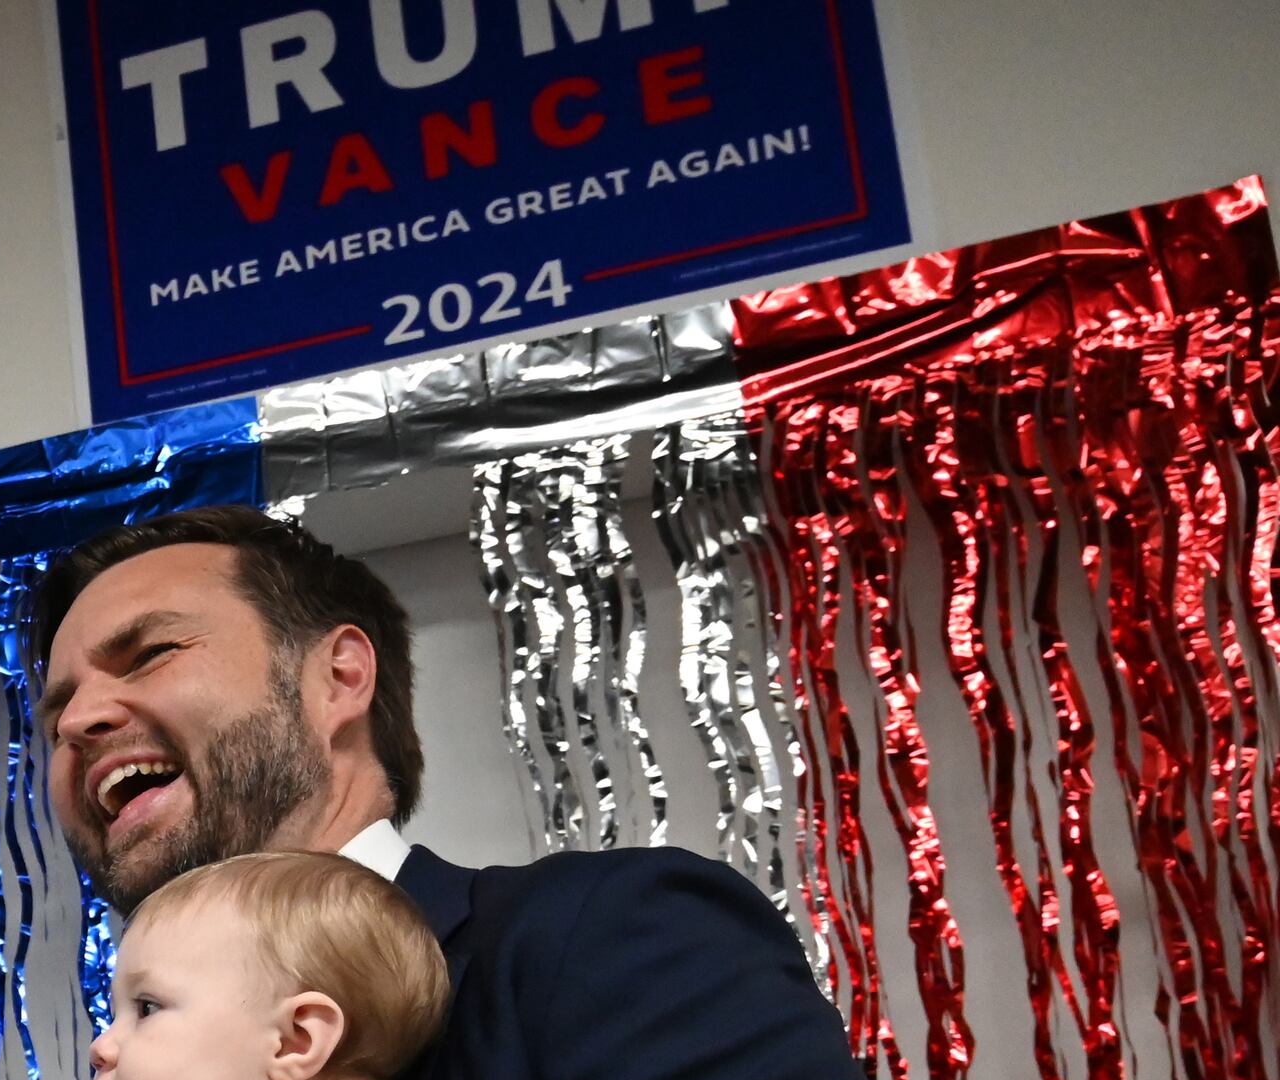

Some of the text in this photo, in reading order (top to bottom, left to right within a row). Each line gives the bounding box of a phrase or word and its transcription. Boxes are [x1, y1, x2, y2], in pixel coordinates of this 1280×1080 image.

[119, 0, 729, 152] TRU
[220, 47, 714, 225] VANCE
[149, 124, 812, 307] MAKE AMERICA GREAT AGAIN!
[381, 258, 572, 346] 2024
